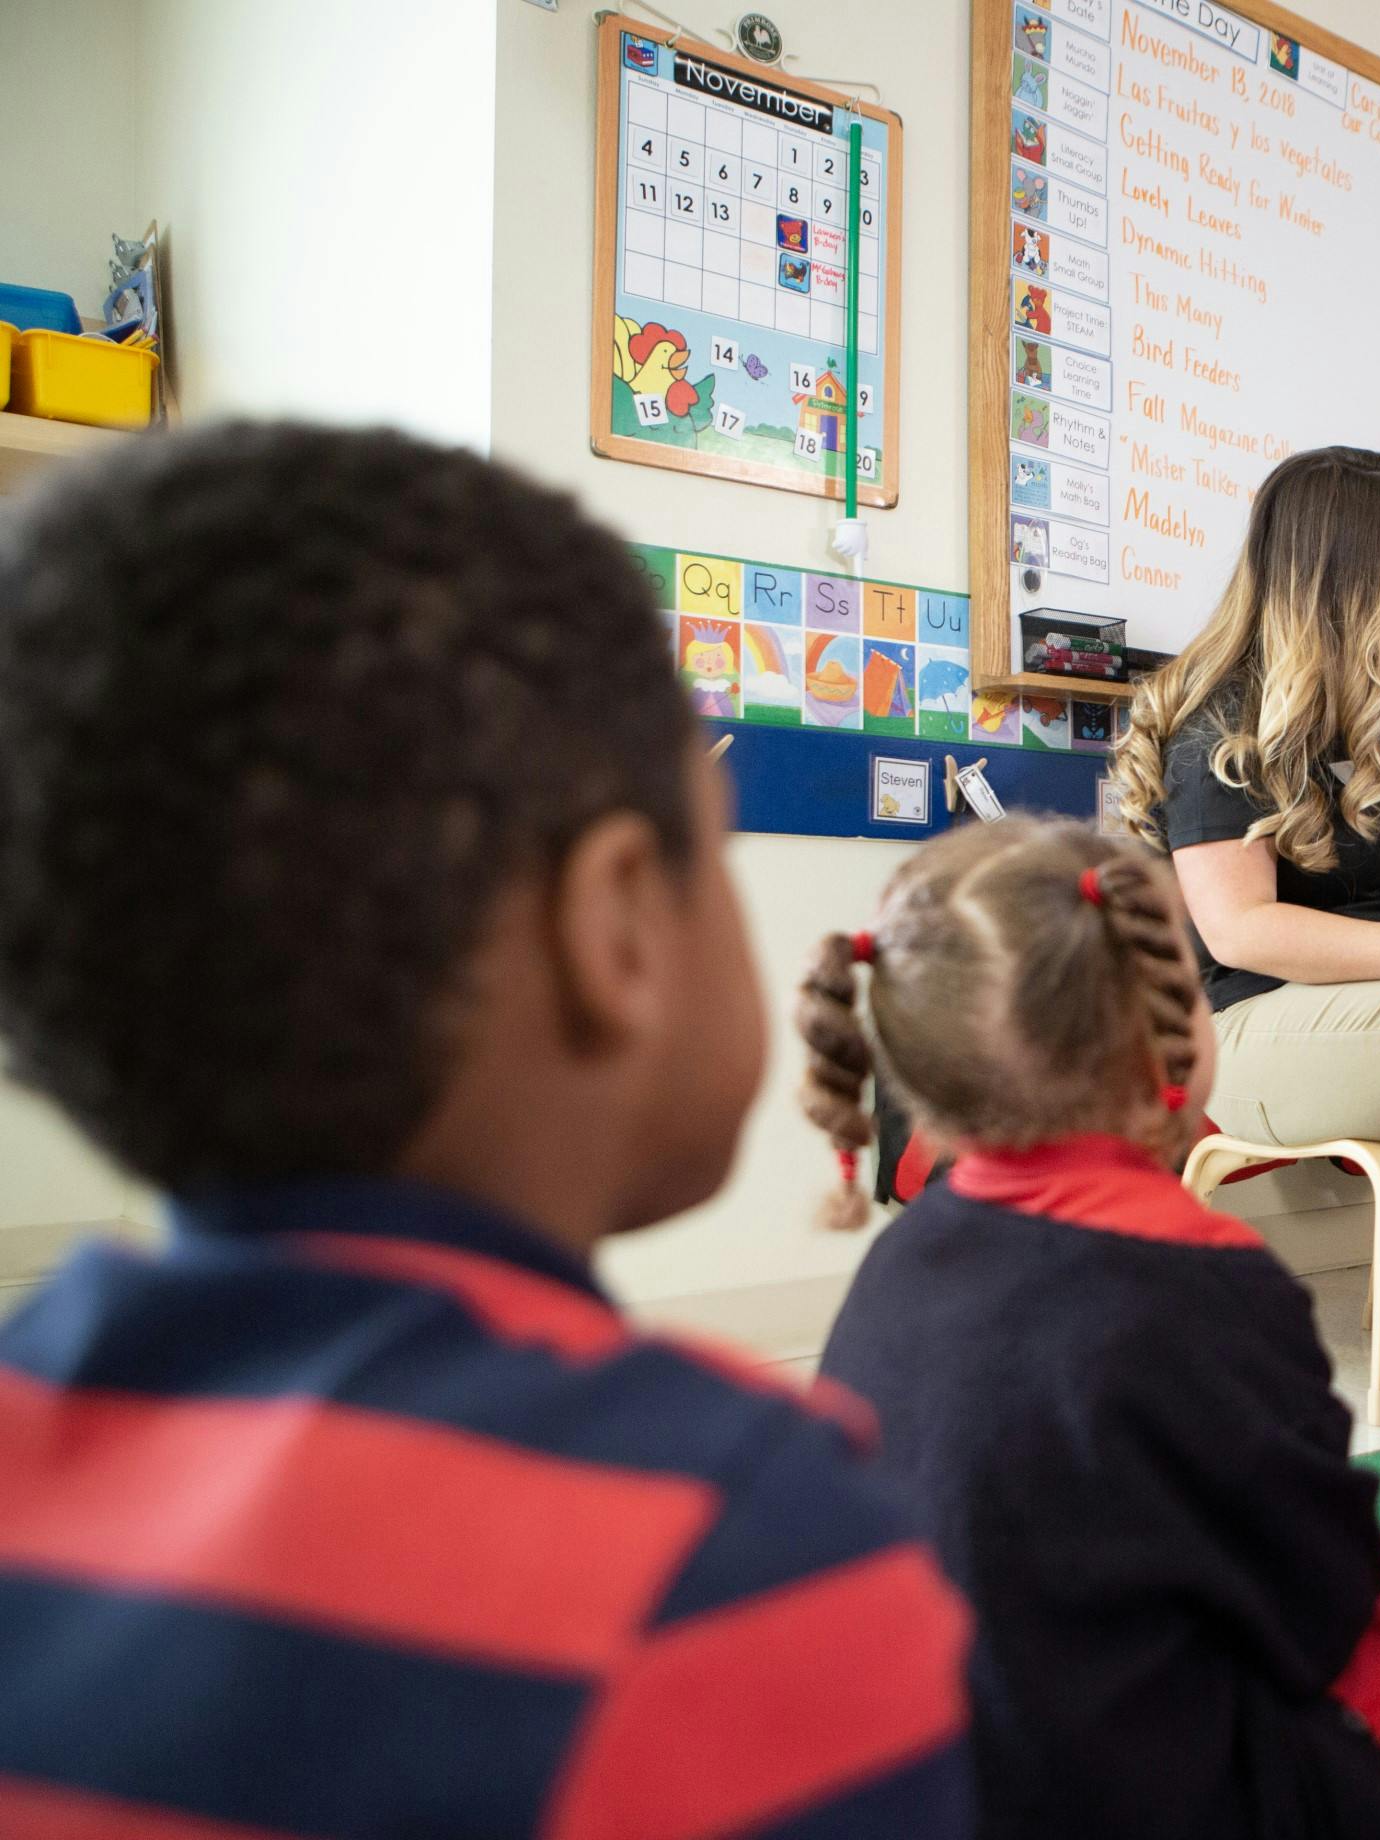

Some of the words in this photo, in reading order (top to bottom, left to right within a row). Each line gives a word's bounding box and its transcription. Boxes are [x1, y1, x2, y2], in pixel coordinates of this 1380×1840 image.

[1067, 2, 1095, 23] Date
[1159, 0, 1190, 17] he
[1199, 1, 1241, 47] Day
[1066, 40, 1096, 62] Mucho
[1065, 54, 1096, 75] Mundo
[1122, 8, 1220, 84] November
[1231, 65, 1250, 103] 13,
[1259, 81, 1295, 119] 2018
[686, 59, 822, 126] November
[1116, 63, 1151, 108] Las
[1157, 84, 1220, 137] Fruitas
[1230, 121, 1240, 151] y
[1251, 121, 1271, 154] los
[1280, 139, 1353, 192] vegetales
[1341, 111, 1362, 135] Our
[642, 140, 653, 157] 4
[680, 151, 690, 167] 5
[792, 149, 798, 163] 1
[1060, 144, 1095, 166] Literacy
[719, 165, 728, 180] 6
[824, 159, 834, 175] 2
[1051, 152, 1074, 169] Small
[1075, 163, 1103, 184] Group
[1120, 112, 1190, 183] Getting
[1199, 153, 1240, 207] Ready
[1249, 179, 1271, 211] for
[1279, 192, 1325, 236] Winter
[752, 175, 762, 190] 7
[860, 171, 869, 186] 3
[640, 183, 657, 202] 11
[789, 188, 799, 204] 8
[1057, 189, 1099, 217] Thumbs
[675, 193, 694, 214] 12
[711, 203, 730, 221] 13
[823, 198, 832, 214] 9
[1122, 167, 1169, 218] Lovely
[1187, 195, 1242, 240] Leaves
[863, 209, 872, 226] 0
[1068, 211, 1087, 229] Up!
[1068, 255, 1091, 270] Math
[1122, 216, 1193, 270] Dynamic
[1199, 247, 1268, 305] Hitting
[1053, 262, 1076, 278] Small
[1077, 271, 1105, 290] Group
[1054, 302, 1084, 320] Project
[1128, 271, 1169, 313] This
[1176, 293, 1223, 340] Many
[1066, 320, 1094, 337] STEAM
[715, 344, 734, 363] 14
[1132, 323, 1174, 369] Bird
[1184, 347, 1241, 393] Feeders
[1065, 356, 1097, 374] Choice
[793, 370, 811, 388] 16
[1063, 369, 1100, 390] Learning
[1072, 385, 1092, 400] Time
[640, 400, 661, 418] 15
[1128, 380, 1165, 424] Fall
[1180, 402, 1259, 451] Magazine
[721, 412, 740, 431] 17
[1052, 411, 1095, 444] Rhythm
[1097, 427, 1107, 440] &
[800, 435, 816, 454] 18
[1063, 434, 1096, 455] Notes
[1066, 478, 1094, 494] Molly's
[1192, 458, 1241, 499] Talker
[1060, 491, 1082, 505] Math
[1083, 498, 1101, 512] Bag
[1123, 486, 1206, 548] Madelyn
[1070, 536, 1090, 550] Og's
[1052, 546, 1088, 566] Reading
[1089, 555, 1107, 570] Bag
[1121, 544, 1184, 591] Connor
[682, 562, 741, 616] Qq
[753, 571, 793, 608] Rr
[815, 581, 850, 617] Ss
[872, 589, 907, 625] Tt
[926, 597, 962, 634] Uu
[880, 771, 923, 789] Steven
